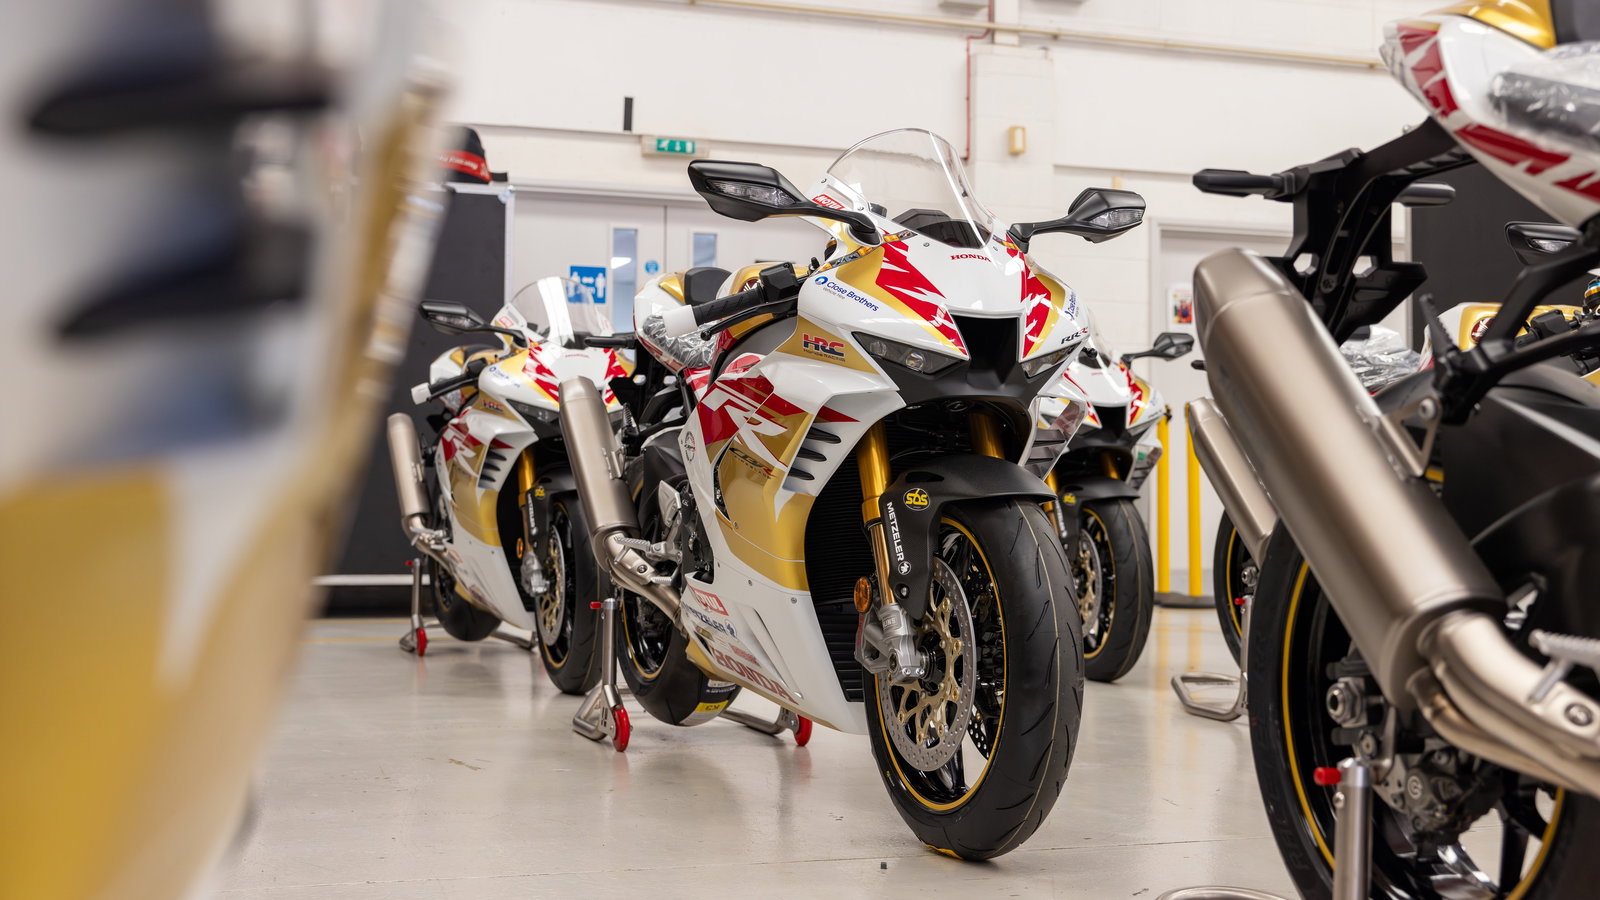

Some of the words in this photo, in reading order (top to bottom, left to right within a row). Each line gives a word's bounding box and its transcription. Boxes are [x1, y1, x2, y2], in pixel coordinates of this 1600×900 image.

[815, 195, 843, 210] MOTUL
[950, 253, 992, 262] HONDA
[826, 281, 847, 295] Close
[846, 292, 879, 312] Brothers
[803, 333, 845, 357] HRC
[886, 501, 905, 562] METZELER
